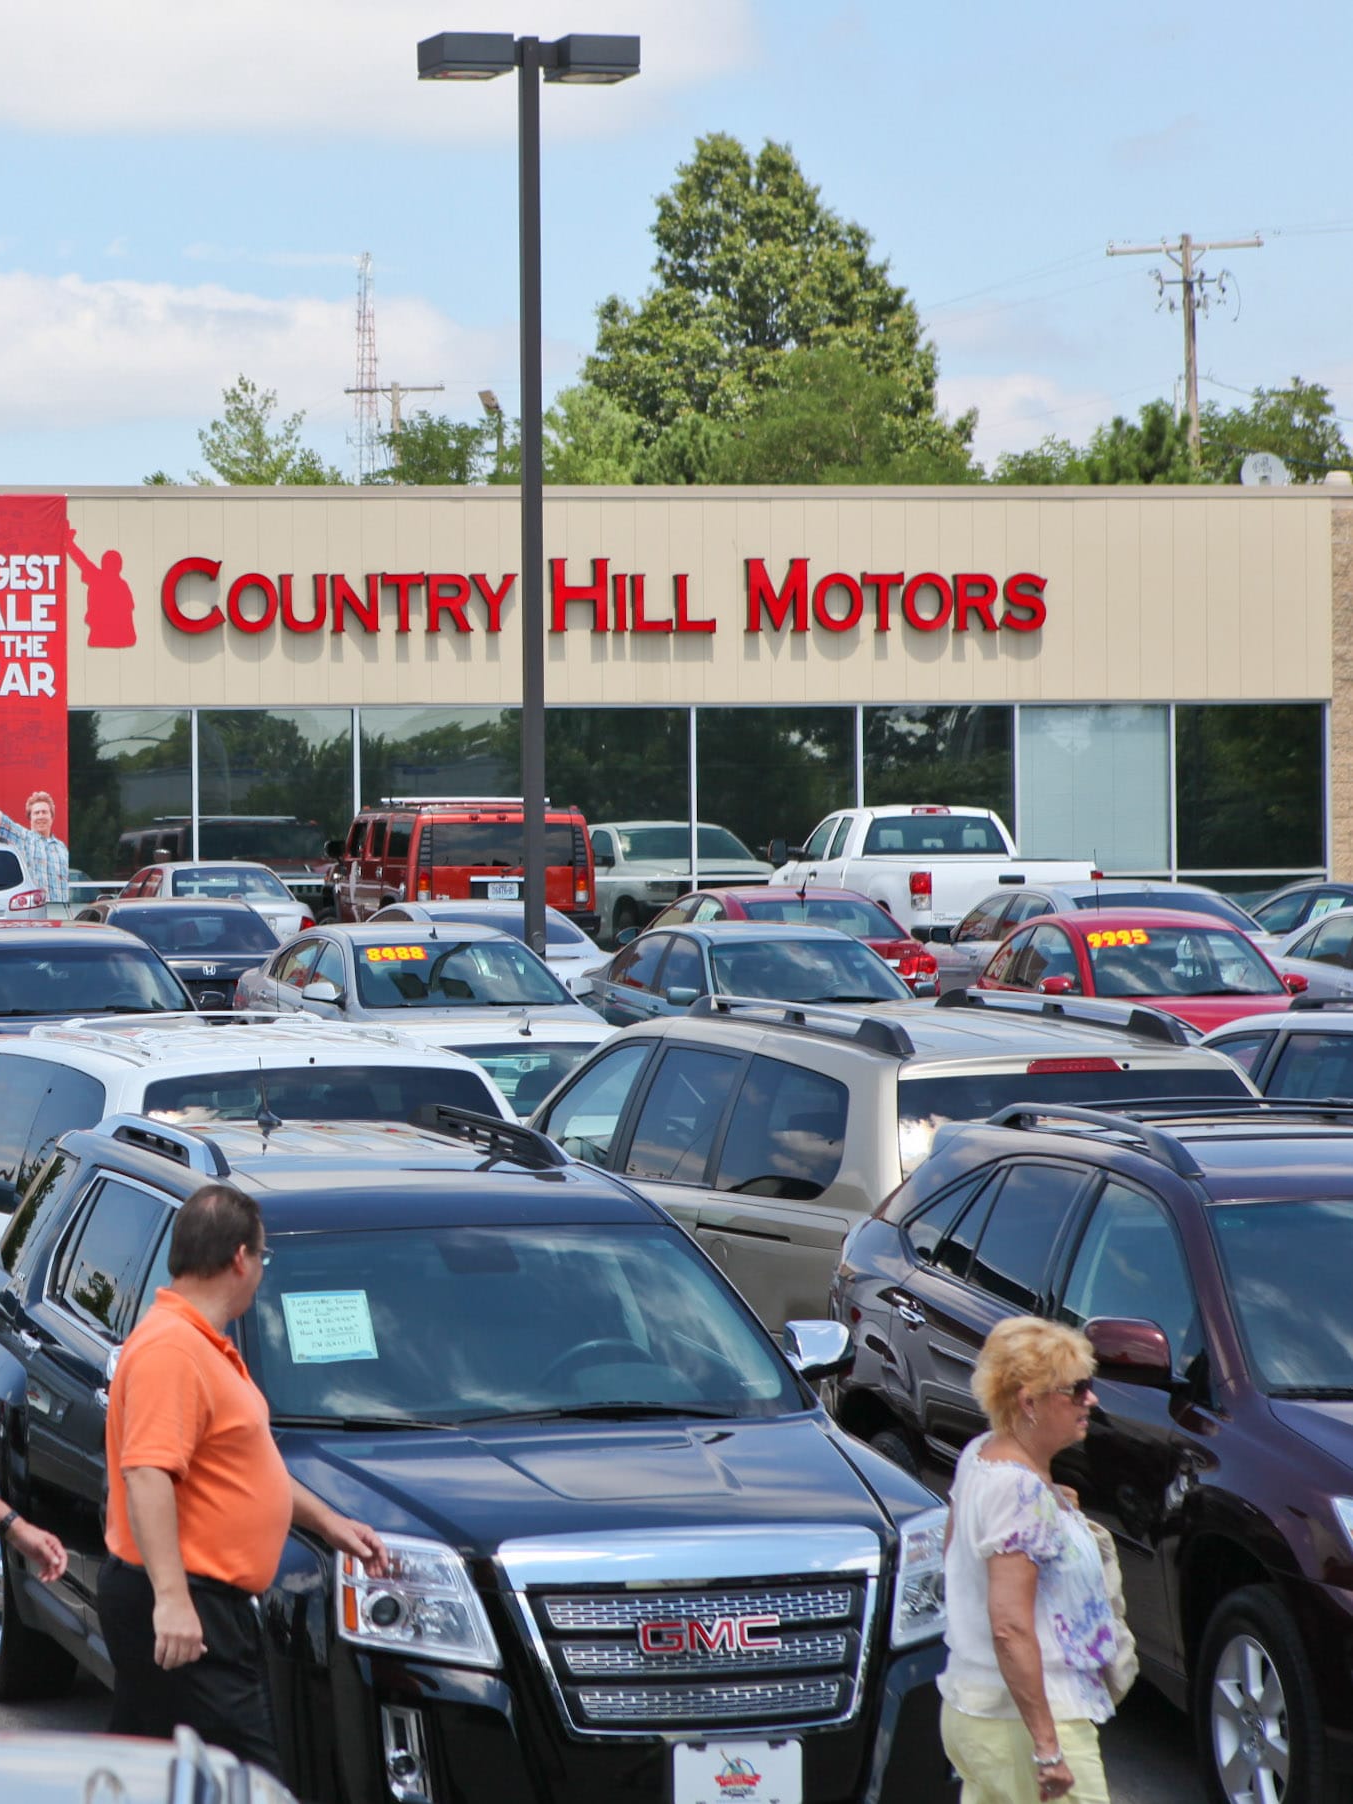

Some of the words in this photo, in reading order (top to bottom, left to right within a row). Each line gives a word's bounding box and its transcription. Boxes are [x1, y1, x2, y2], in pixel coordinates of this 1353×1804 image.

[161, 557, 518, 634] COUNTRY
[548, 558, 716, 633] HILL
[744, 558, 1047, 633] MOTORS
[0, 635, 48, 658] THE
[1086, 929, 1148, 948] 9995
[639, 1614, 782, 1655] GMC
